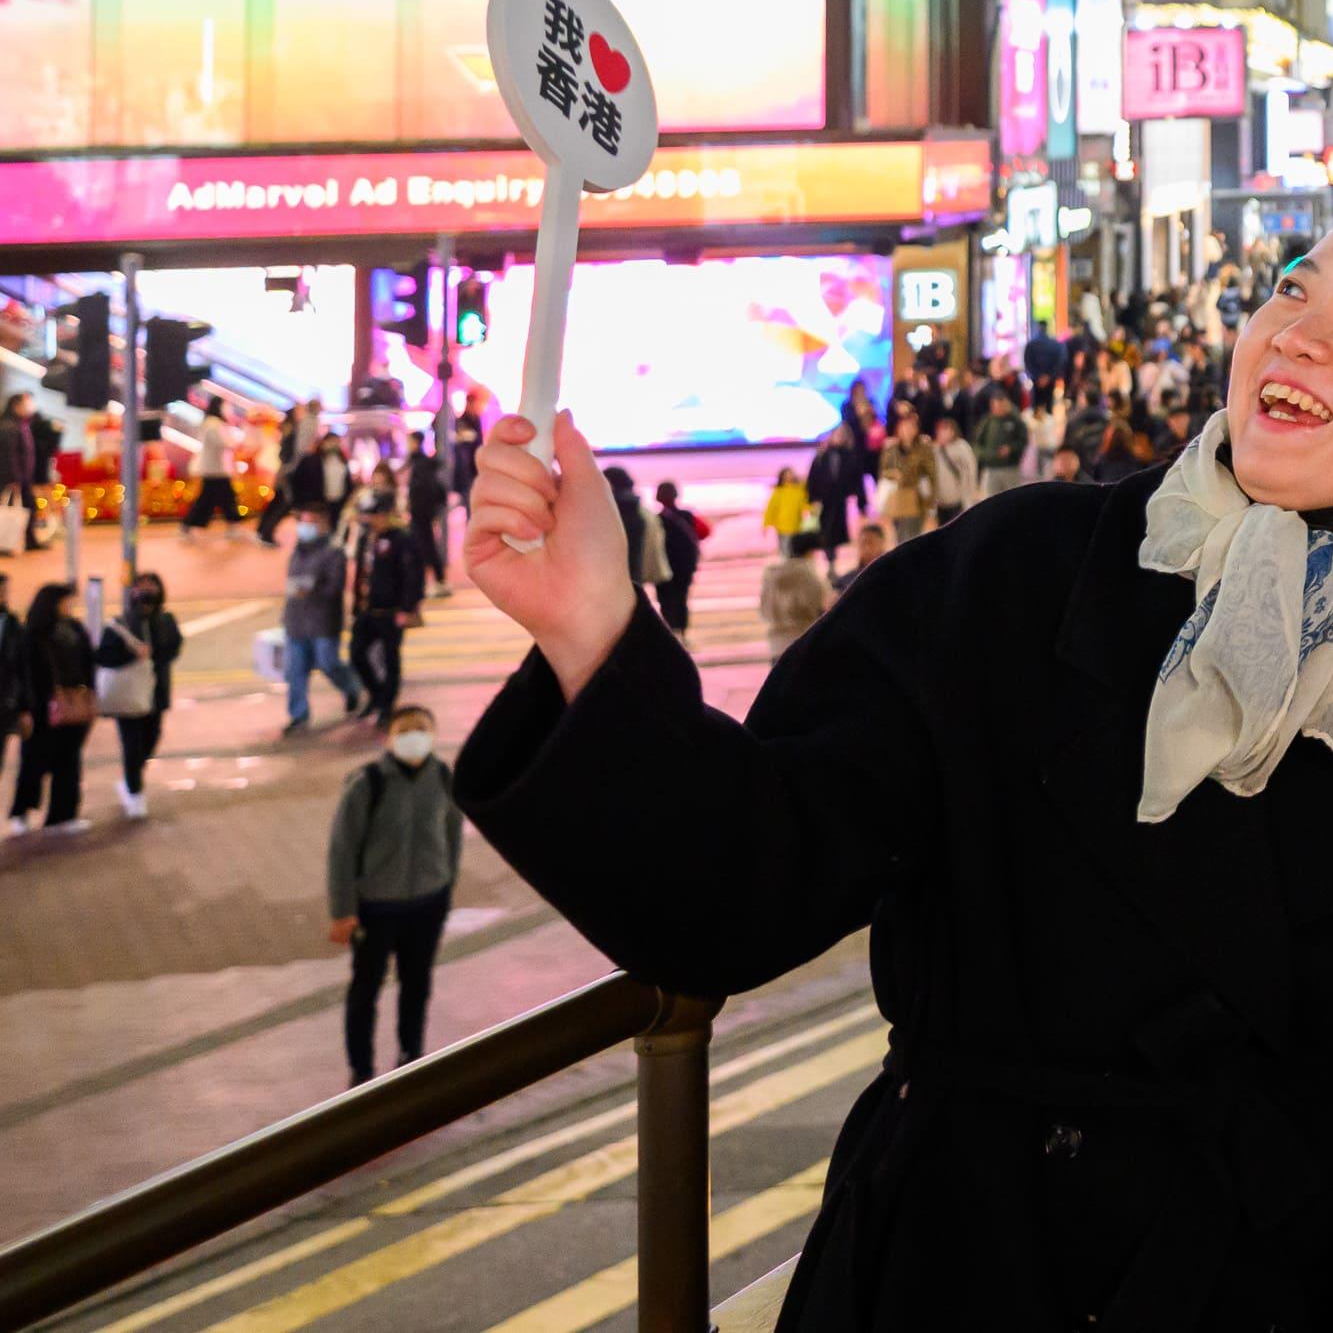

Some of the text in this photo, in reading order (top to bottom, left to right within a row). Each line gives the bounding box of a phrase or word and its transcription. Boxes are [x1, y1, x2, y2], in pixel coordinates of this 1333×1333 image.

[536, 42, 623, 157] 香港
[167, 174, 543, 210] AdMarvel Ad Enquiry
